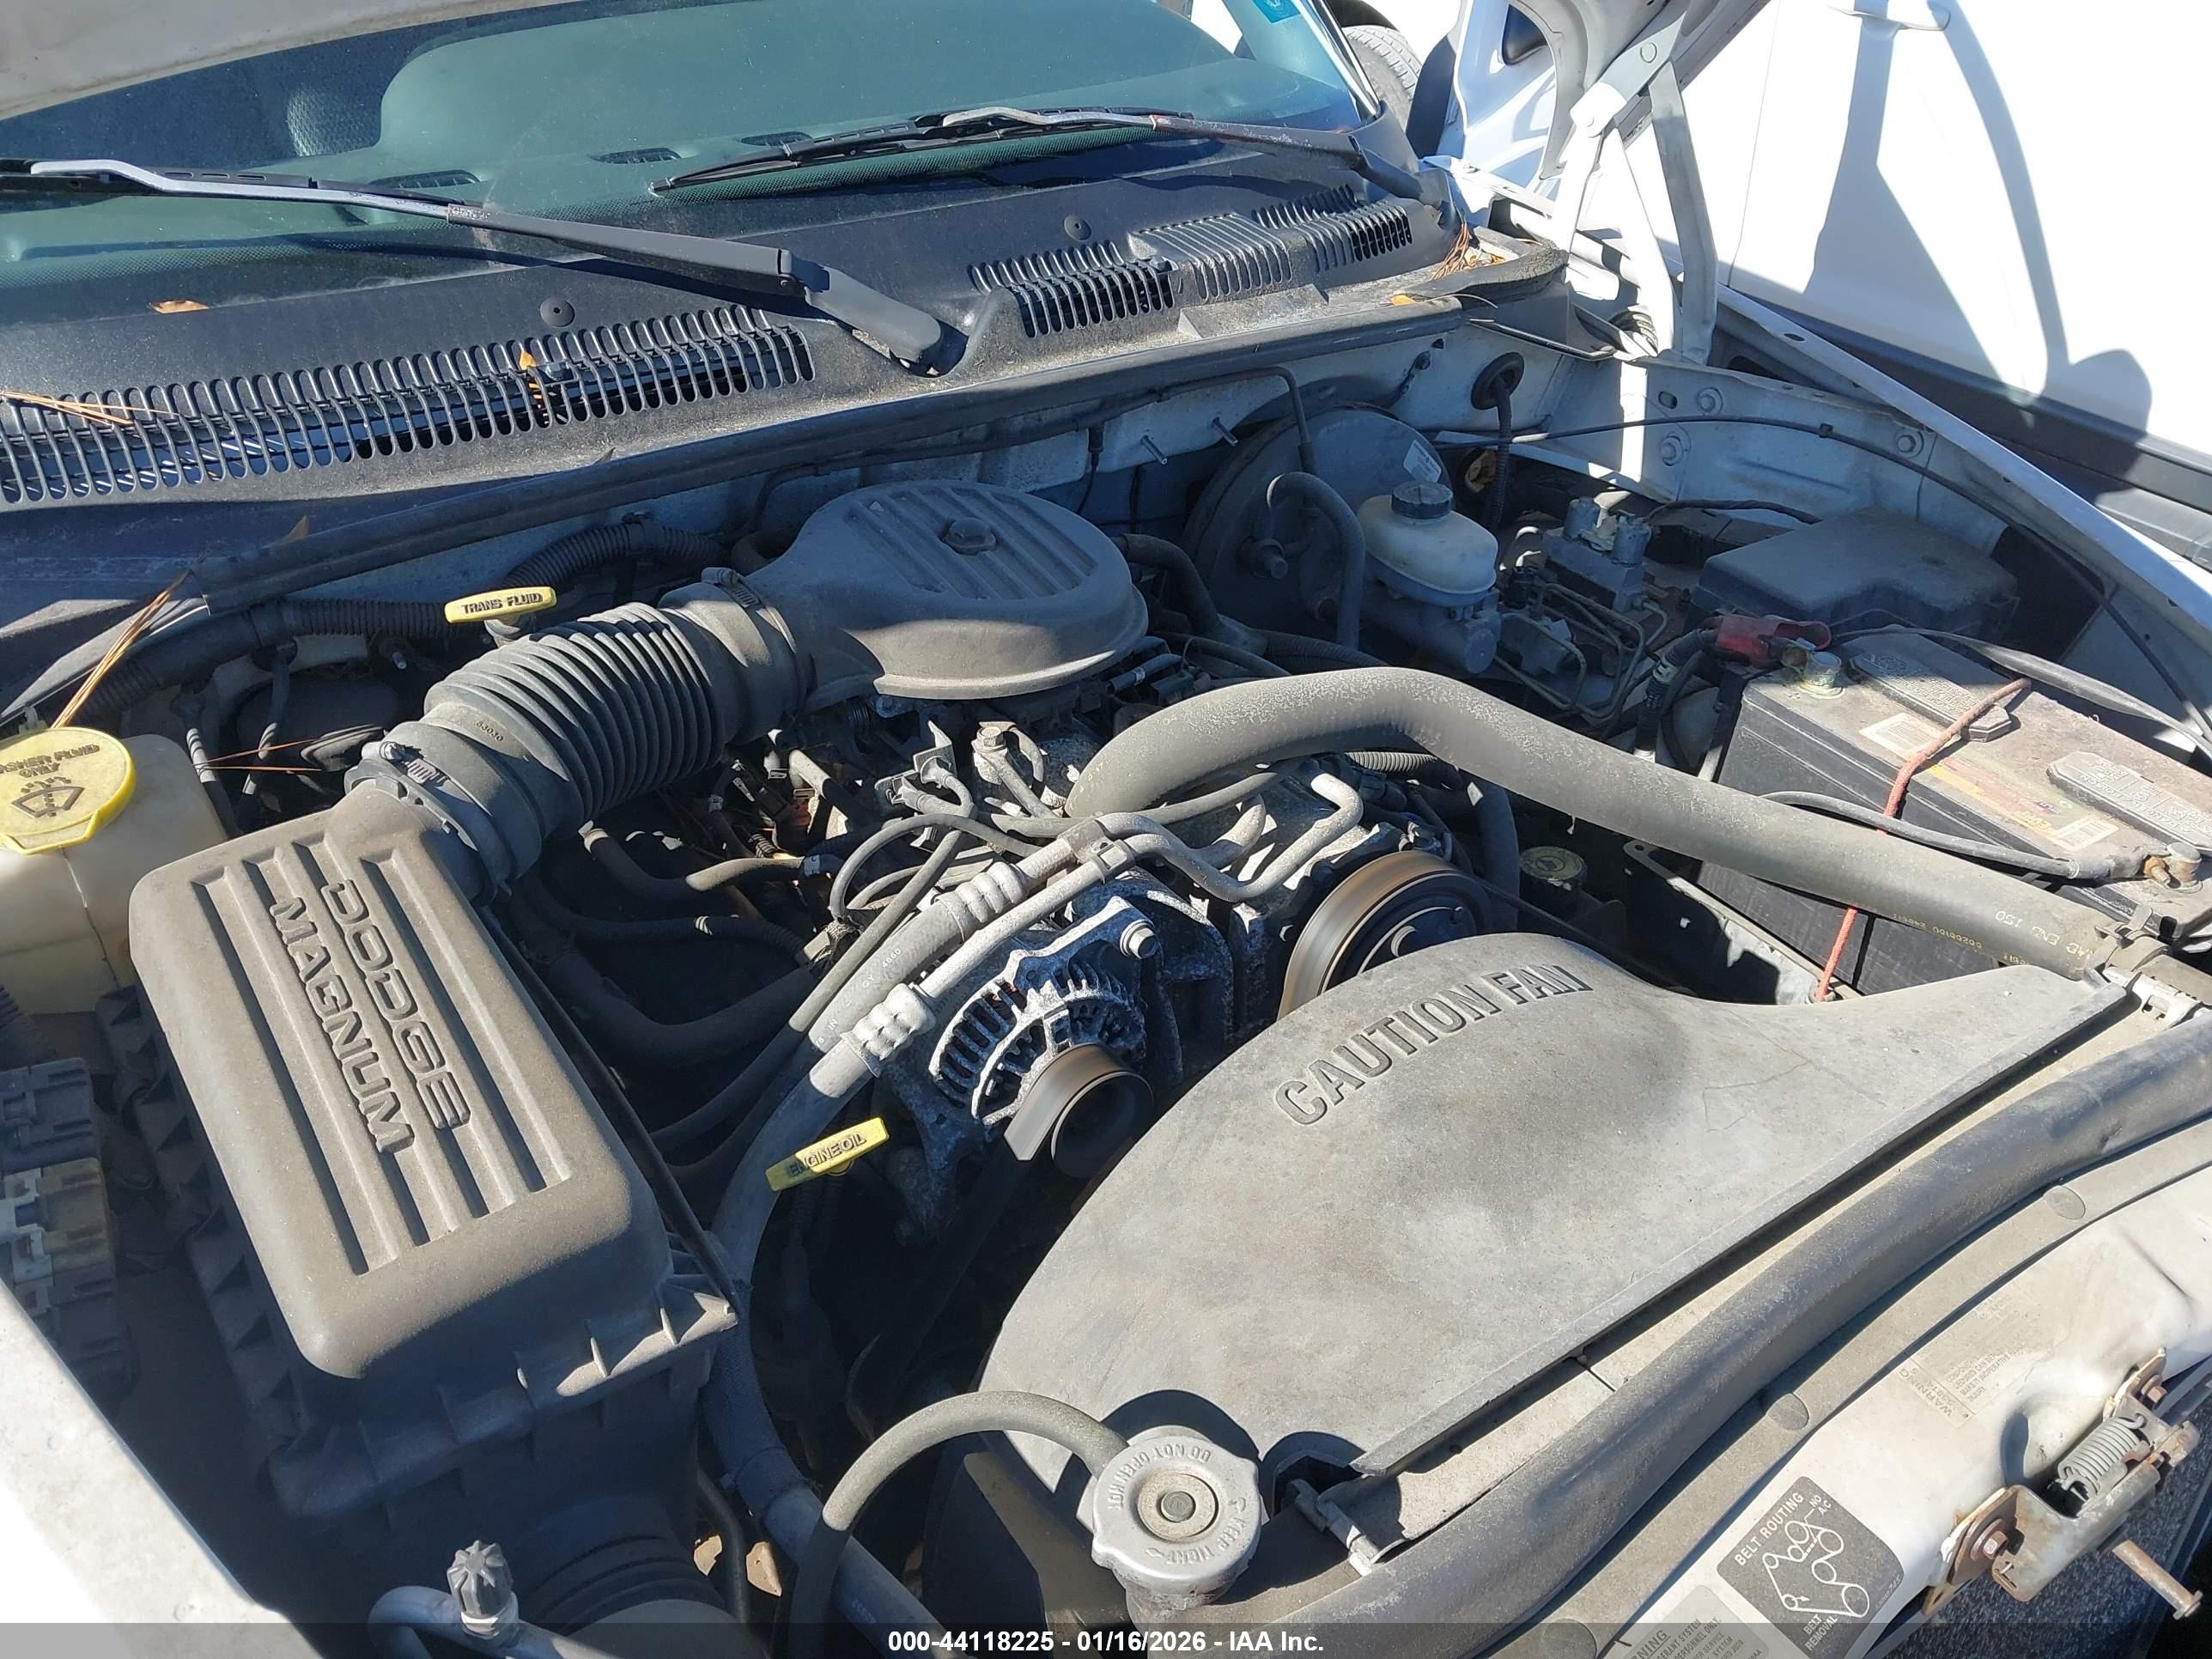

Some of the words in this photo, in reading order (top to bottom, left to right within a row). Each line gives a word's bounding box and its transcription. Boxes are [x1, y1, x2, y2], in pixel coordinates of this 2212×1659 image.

[461, 599, 503, 614] TRANS
[507, 592, 544, 606] FLUID
[54, 744, 100, 761] FLUID
[320, 878, 471, 1130] DODGE
[269, 896, 415, 1154] MAGNUM
[1274, 983, 1502, 1125] CAUTION
[1481, 964, 1594, 1006] FAN
[1153, 1443, 1185, 1458] NOT
[1190, 1445, 1212, 1463] DO
[1114, 1450, 1151, 1483] OPEN
[1808, 1495, 1821, 1507] NO
[1735, 1536, 1762, 1566] BELT
[1759, 1492, 1804, 1540] ROUTING
[1803, 1613, 1822, 1635] BELT
[1806, 1615, 1839, 1651] REMOVAL
